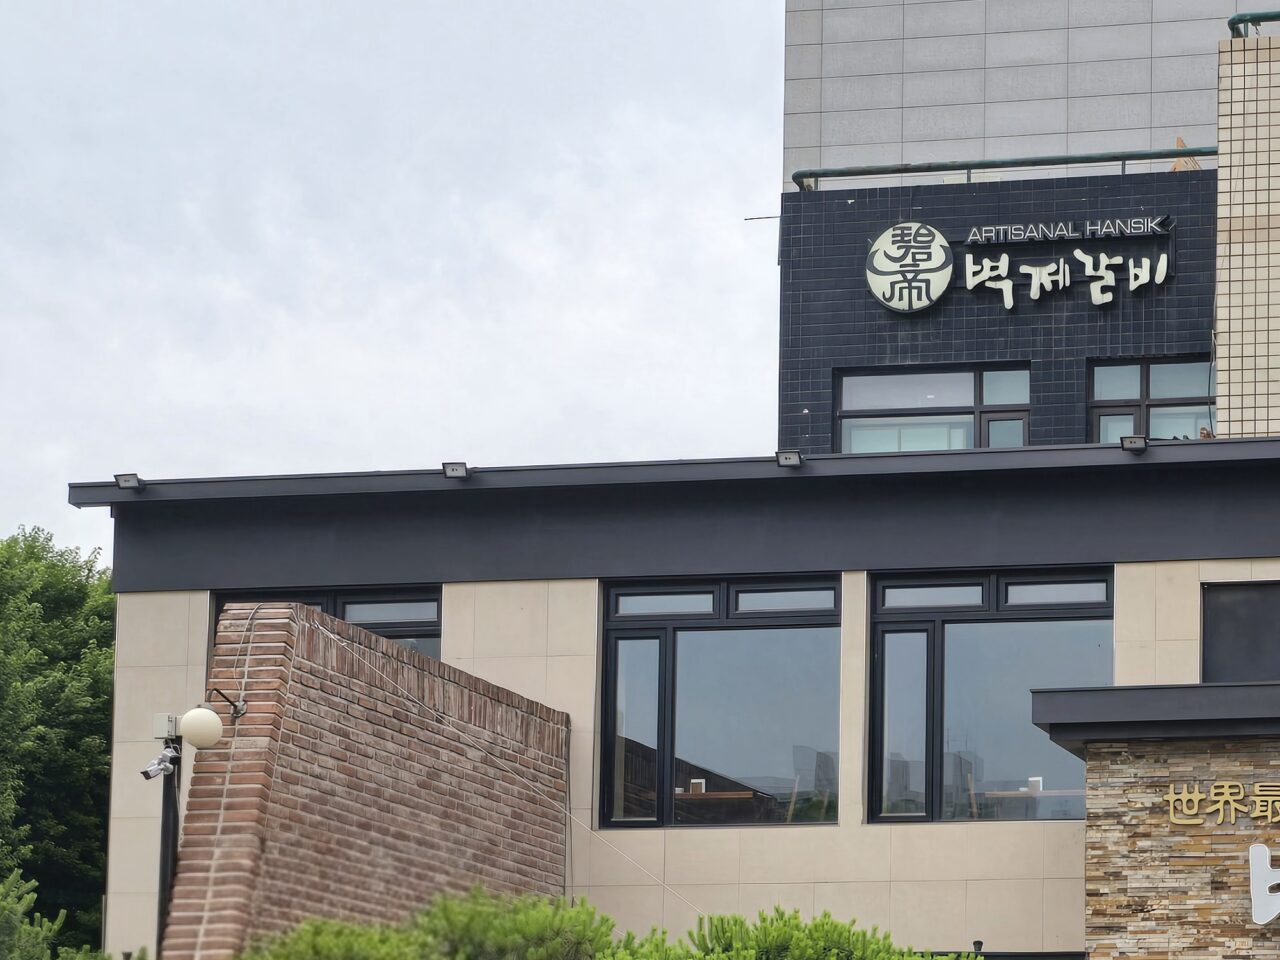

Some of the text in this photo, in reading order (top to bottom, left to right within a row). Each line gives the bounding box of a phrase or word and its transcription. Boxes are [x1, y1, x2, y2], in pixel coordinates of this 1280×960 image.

[967, 217, 1163, 243] ARTISANAL HANSIK
[965, 248, 1168, 310] 벽제갈비
